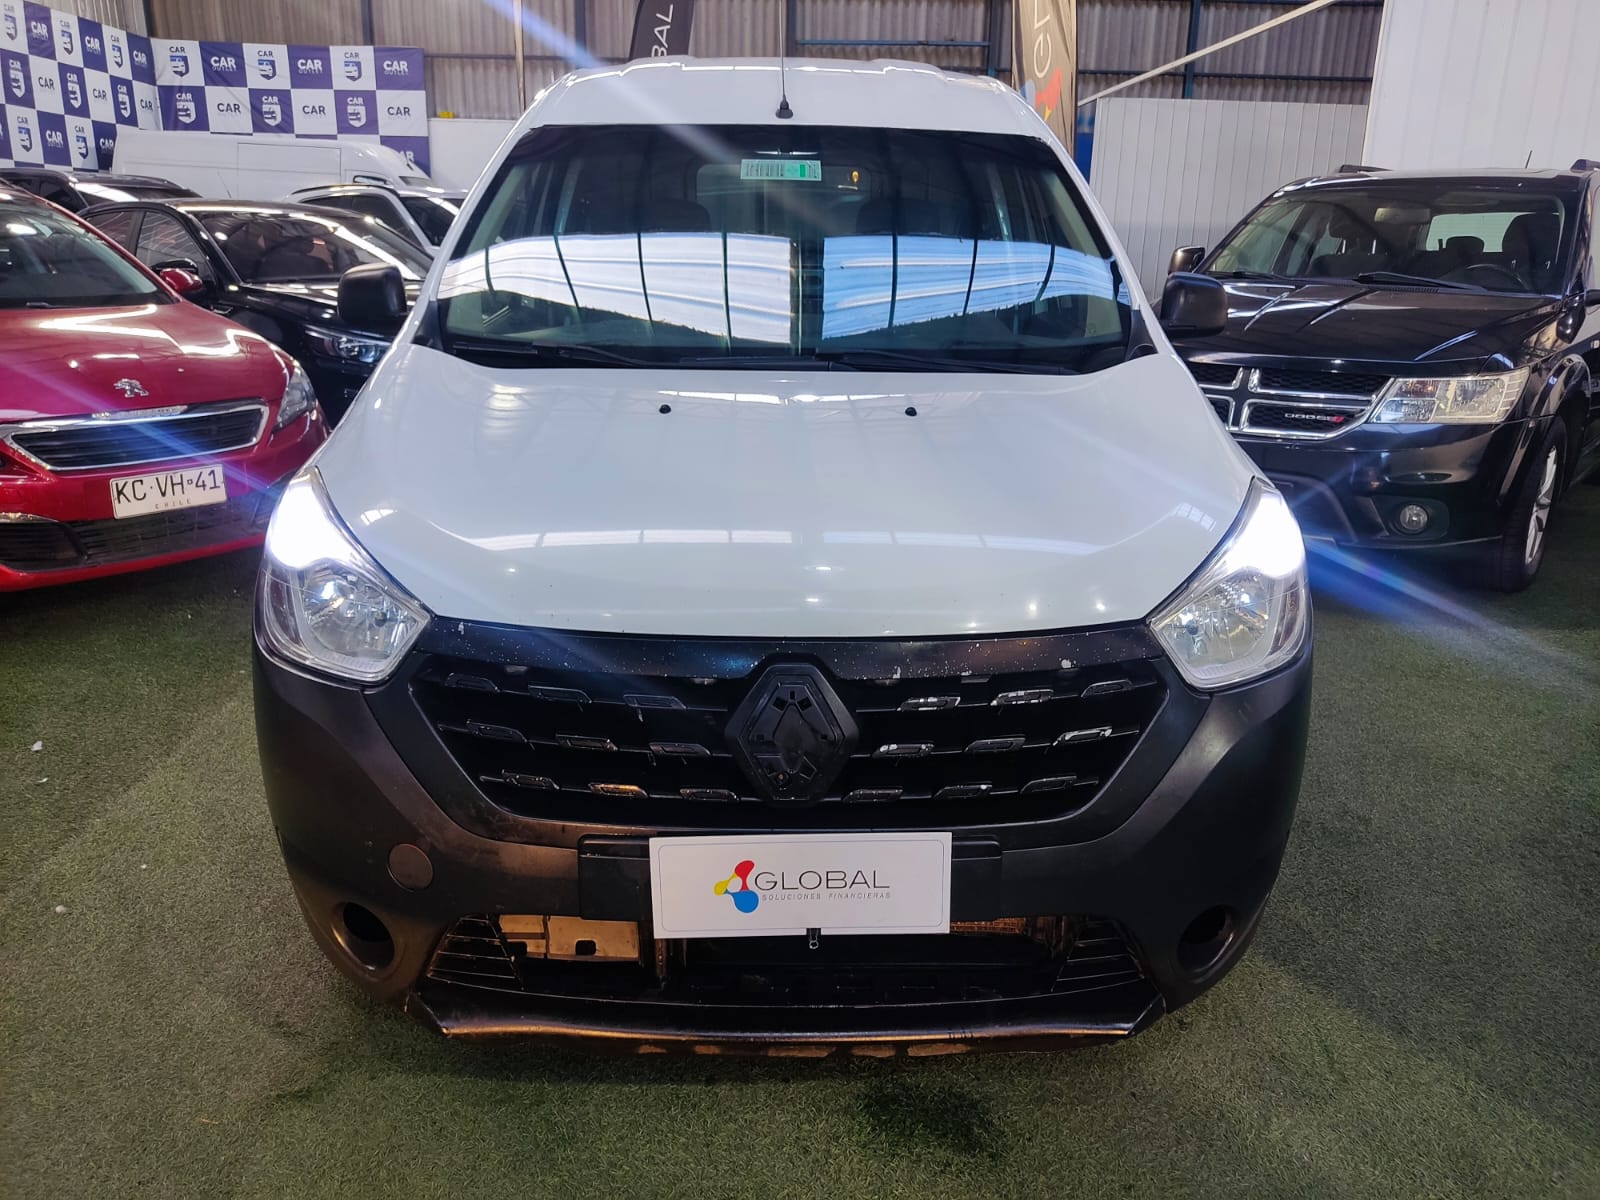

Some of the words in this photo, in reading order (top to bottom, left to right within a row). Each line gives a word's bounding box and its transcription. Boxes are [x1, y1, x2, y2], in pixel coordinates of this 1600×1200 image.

[31, 21, 49, 37] CAR
[85, 35, 100, 51] CAR
[211, 56, 236, 69] CAR
[297, 59, 322, 71] CAR
[383, 60, 408, 72] CAR
[38, 76, 55, 90] CAR
[93, 88, 107, 100] CAR
[176, 93, 192, 101] CAR
[140, 98, 153, 111] CAR
[262, 96, 279, 104] CAR
[347, 97, 364, 105] CAR
[217, 103, 241, 113] CAR
[302, 105, 326, 115] CAR
[387, 106, 411, 116] CAR
[74, 125, 84, 133] CAR
[46, 129, 63, 144] CAR
[99, 138, 113, 148] CAR
[154, 498, 191, 509] CHILE
[754, 870, 890, 891] GLOBAL
[762, 893, 821, 901] SOLUCIONES
[828, 892, 891, 900] FINANCIERAS
